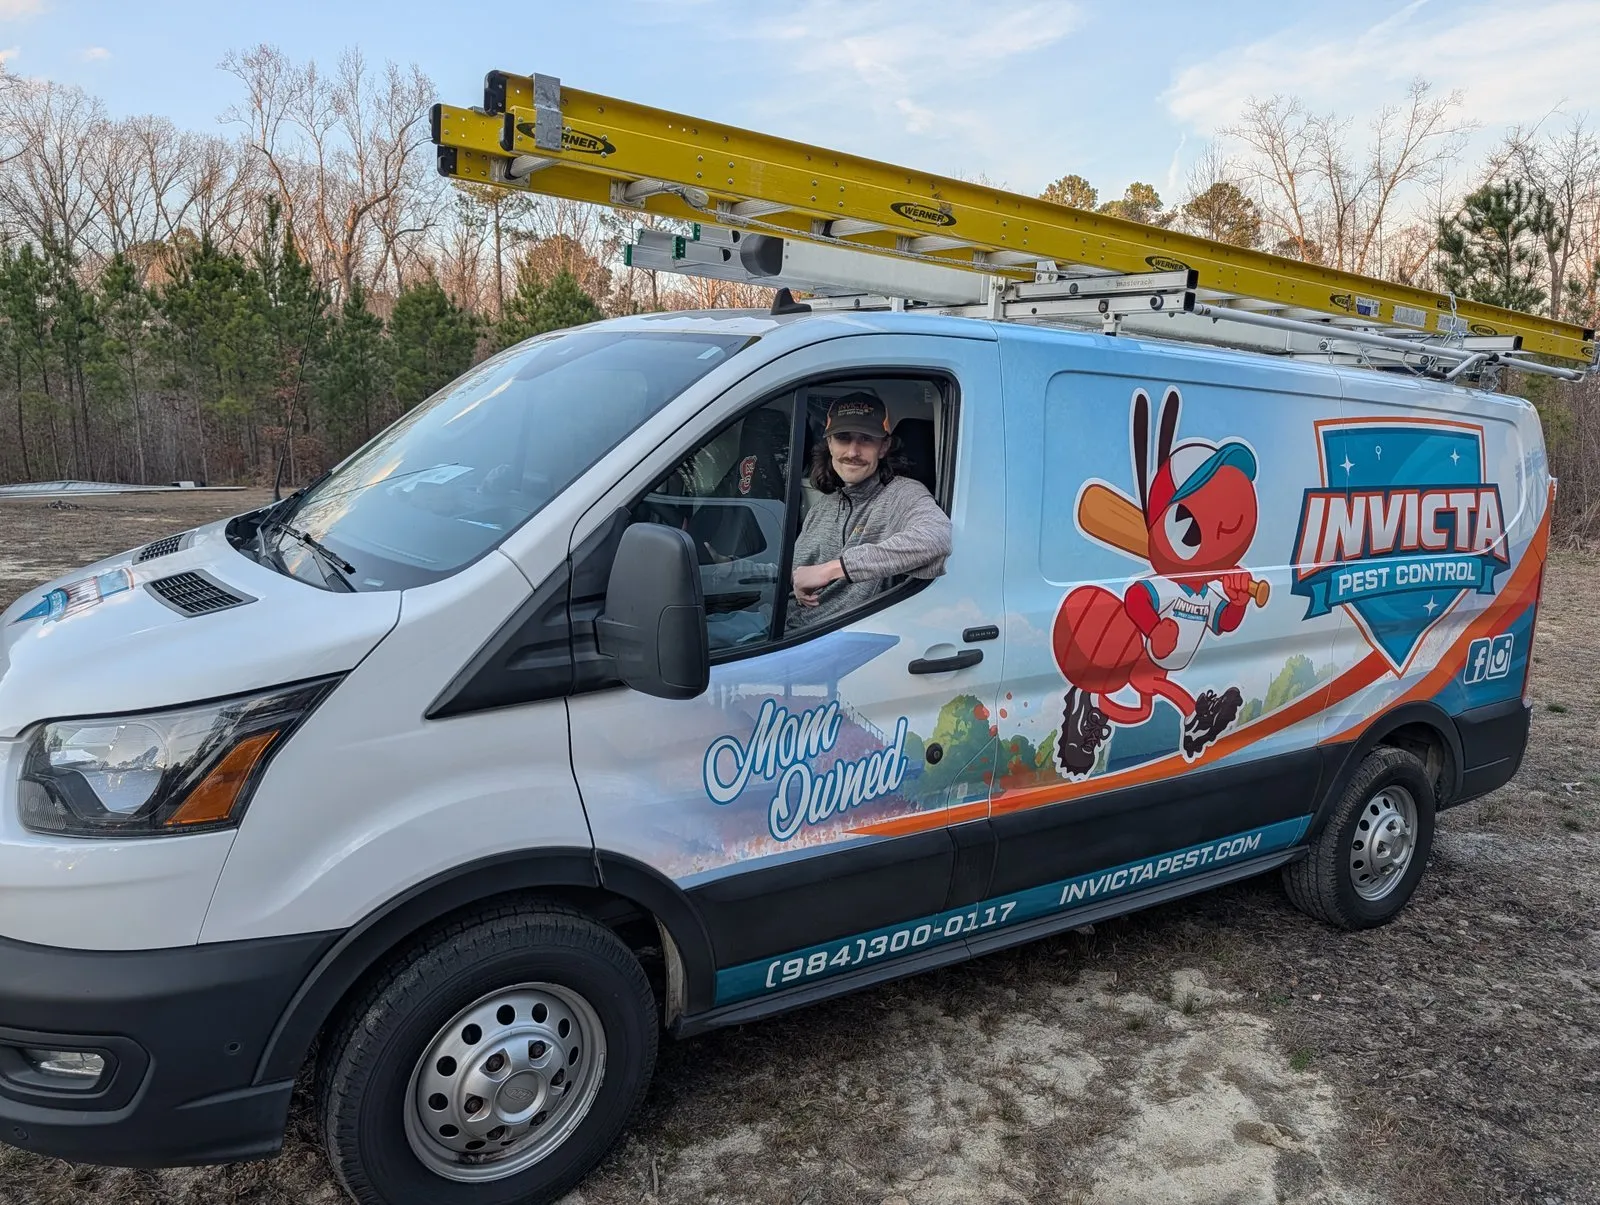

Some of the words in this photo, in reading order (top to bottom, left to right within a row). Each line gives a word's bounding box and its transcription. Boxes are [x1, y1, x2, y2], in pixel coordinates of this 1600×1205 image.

[561, 133, 598, 150] RNER
[904, 206, 945, 222] WERNER
[1154, 259, 1184, 270] WERNER
[1298, 488, 1508, 580] INVICTA
[1338, 568, 1390, 596] PEST
[1396, 562, 1476, 585] CONTROL
[1174, 598, 1210, 616] INVICTA
[703, 698, 842, 804] Mom
[768, 717, 908, 841] Owned
[1059, 833, 1262, 905] INVICTAPEST.COM
[765, 901, 1017, 988] (984)300-0117
